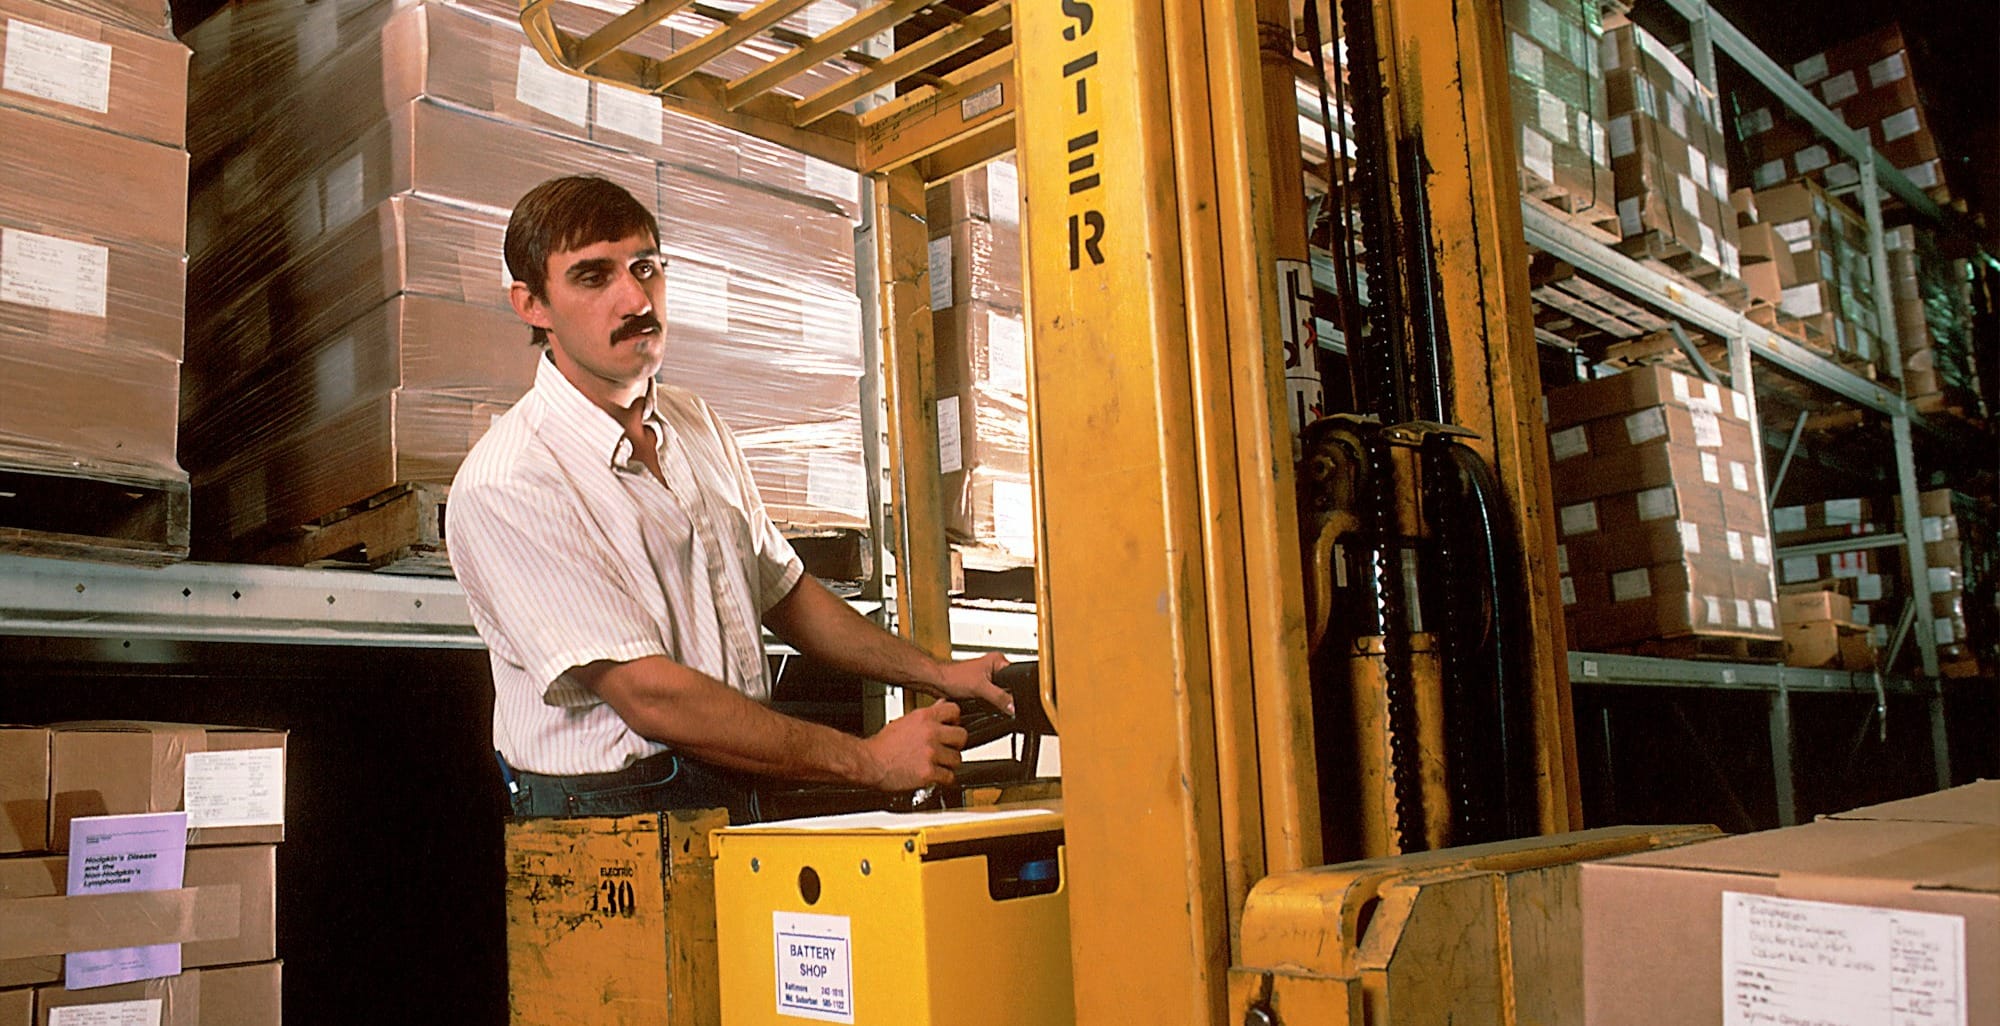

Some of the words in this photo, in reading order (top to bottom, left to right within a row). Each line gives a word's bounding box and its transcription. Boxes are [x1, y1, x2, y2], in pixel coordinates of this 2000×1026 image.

[85, 856, 124, 864] Hodgkin's
[84, 869, 141, 878] Non-Hodgkin's
[600, 867, 633, 877] ELECTRIC
[83, 878, 131, 886] Lymphomas
[790, 944, 836, 960] BATTERY
[800, 963, 827, 977] SHOP
[785, 982, 808, 992] Baltimore
